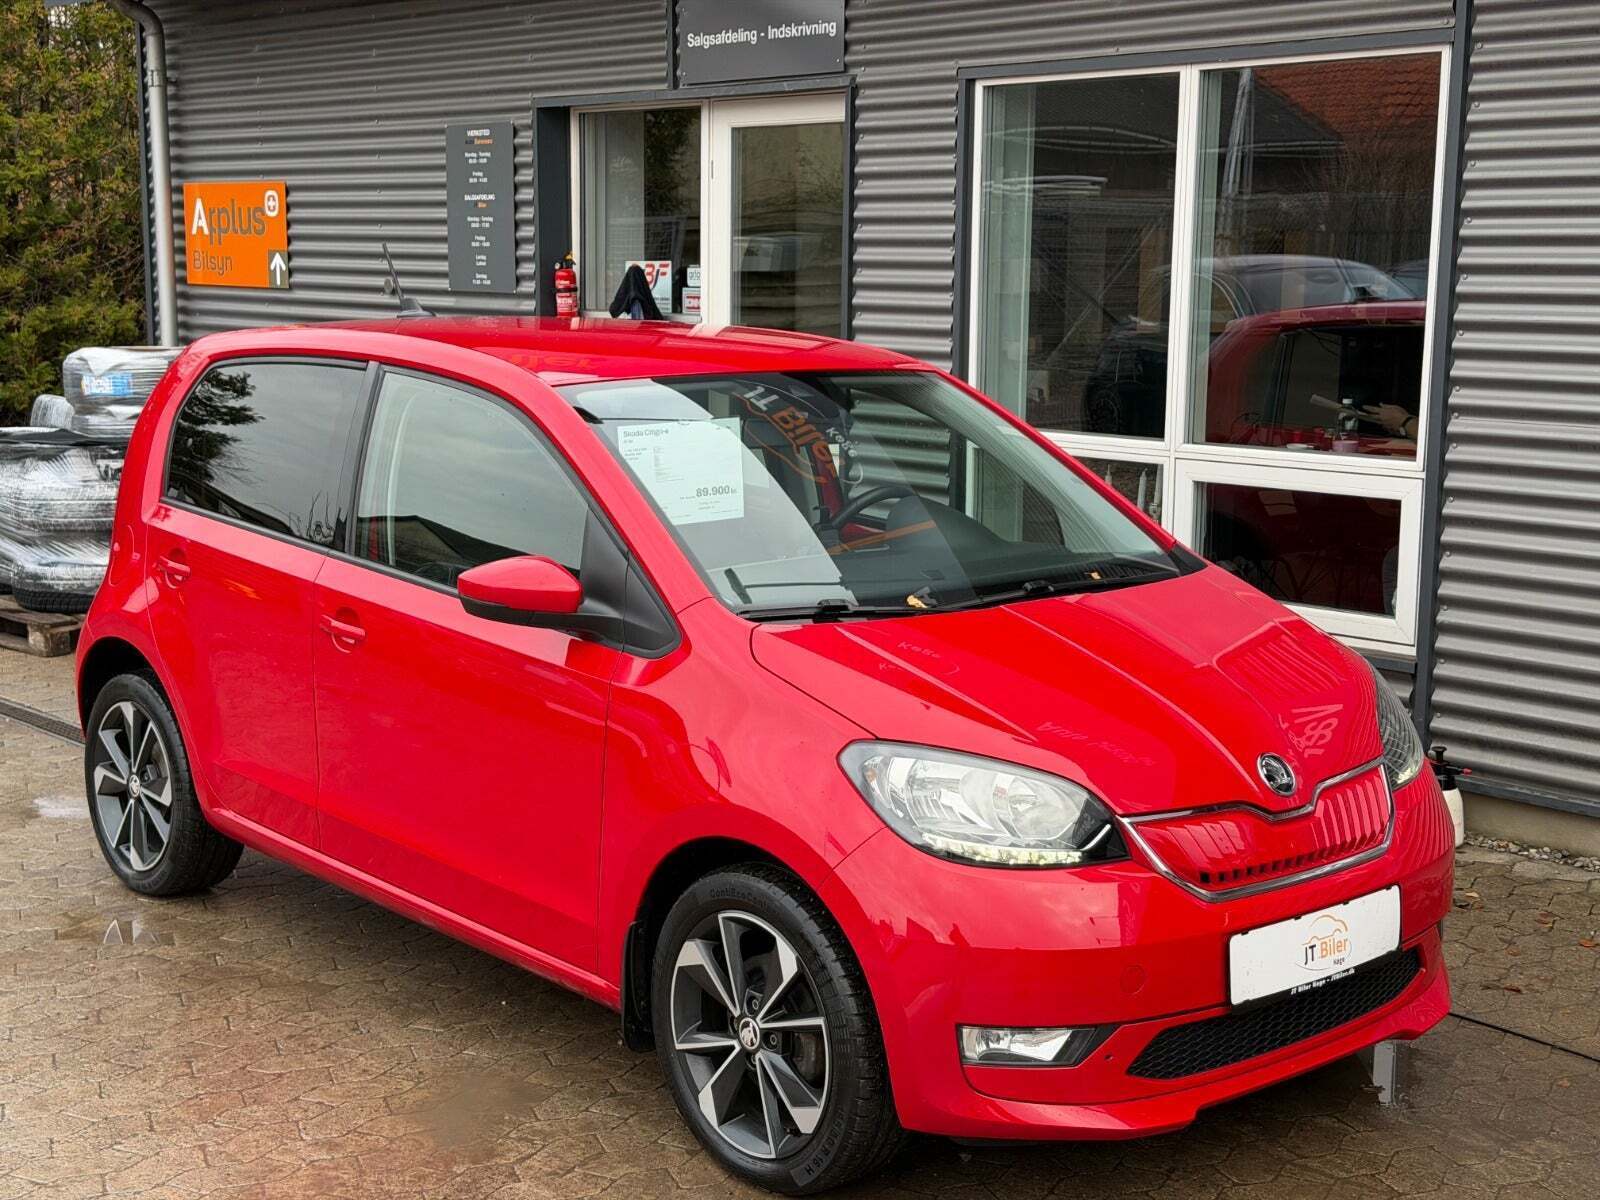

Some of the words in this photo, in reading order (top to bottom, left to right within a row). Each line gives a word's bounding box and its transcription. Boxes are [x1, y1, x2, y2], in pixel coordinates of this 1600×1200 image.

[687, 28, 758, 49] Salgsafdeling
[767, 20, 837, 40] Indskrivning
[193, 250, 233, 276] Bilsyn
[696, 485, 730, 498] 89.900
[1304, 944, 1317, 966] JT
[1320, 938, 1348, 959] Biler
